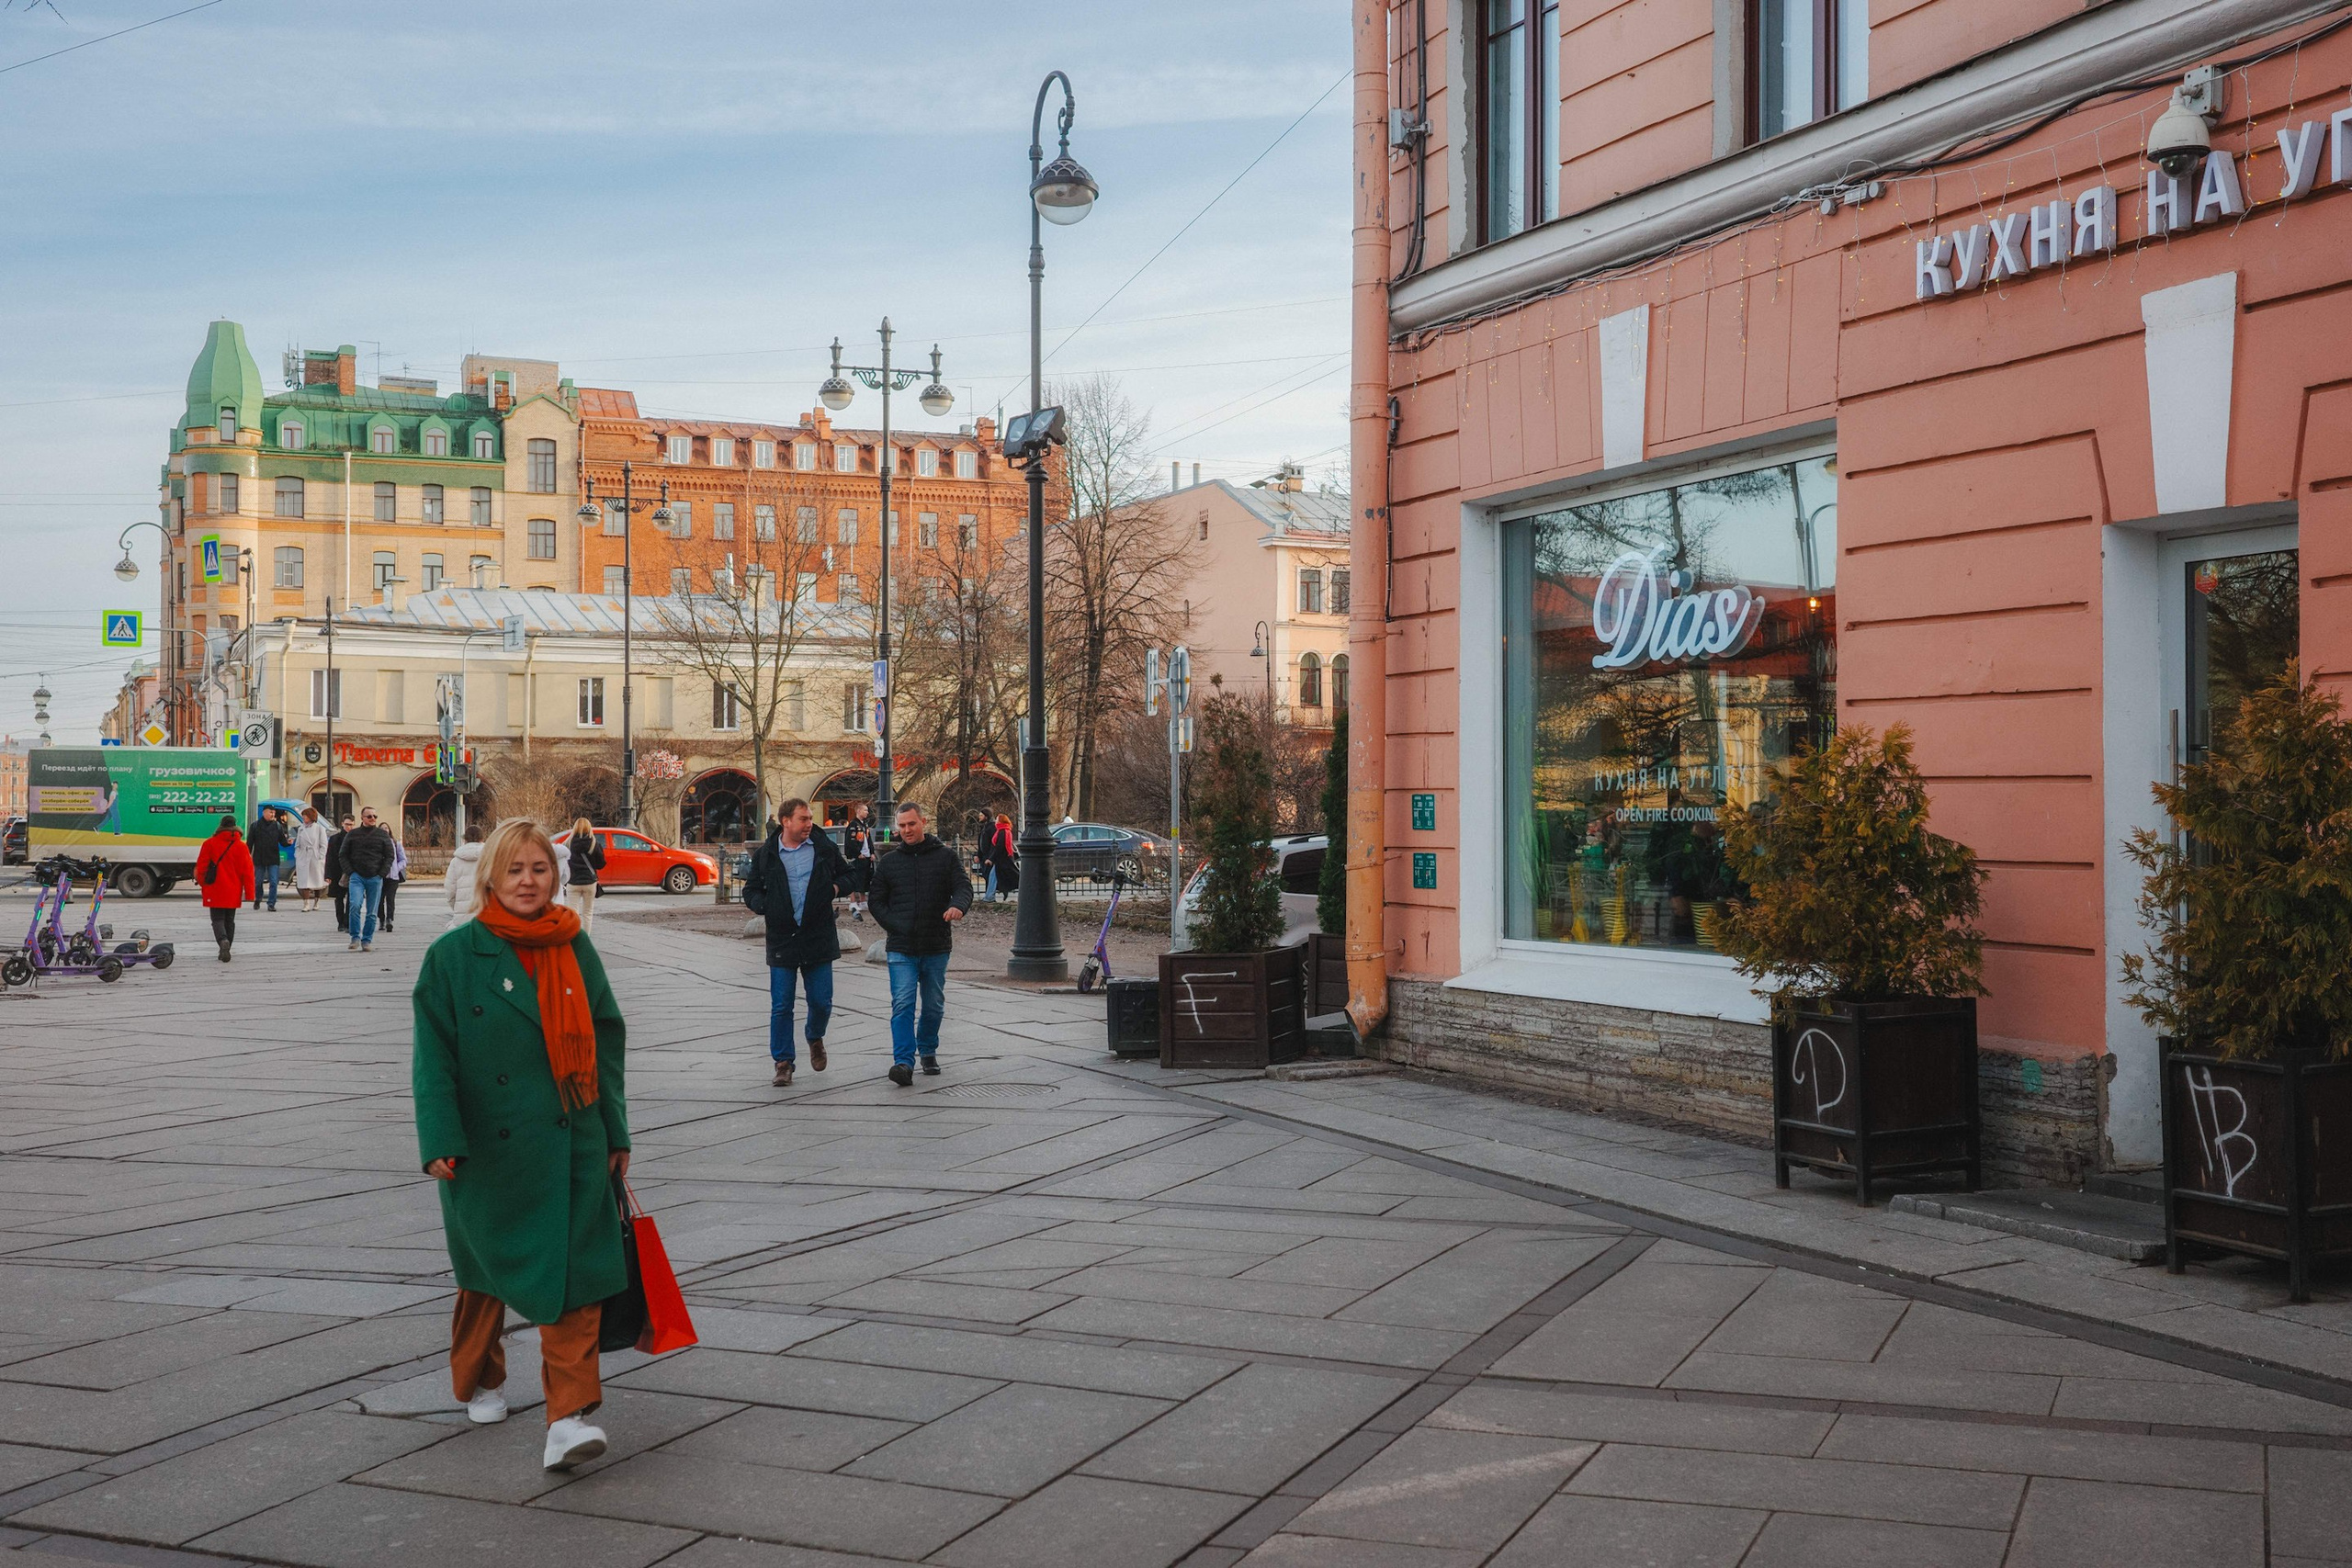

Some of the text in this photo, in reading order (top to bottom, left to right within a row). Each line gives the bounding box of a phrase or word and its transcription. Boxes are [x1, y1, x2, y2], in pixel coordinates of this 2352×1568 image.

[1916, 186, 2117, 300] КУХНЯ
[2146, 151, 2245, 236] НА
[1592, 541, 1766, 671] Dias
[333, 742, 415, 763] Taverna
[41, 764, 76, 773] Переезд
[77, 764, 96, 773] идёт
[149, 767, 236, 777] грузовичкоф
[1594, 767, 1648, 792] КУХНЯ
[1657, 765, 1679, 790] НА
[163, 791, 236, 803] 222-22-22
[1615, 807, 1644, 822] OPEN
[1646, 807, 1668, 822] FIRE
[1177, 970, 1238, 1034] F
